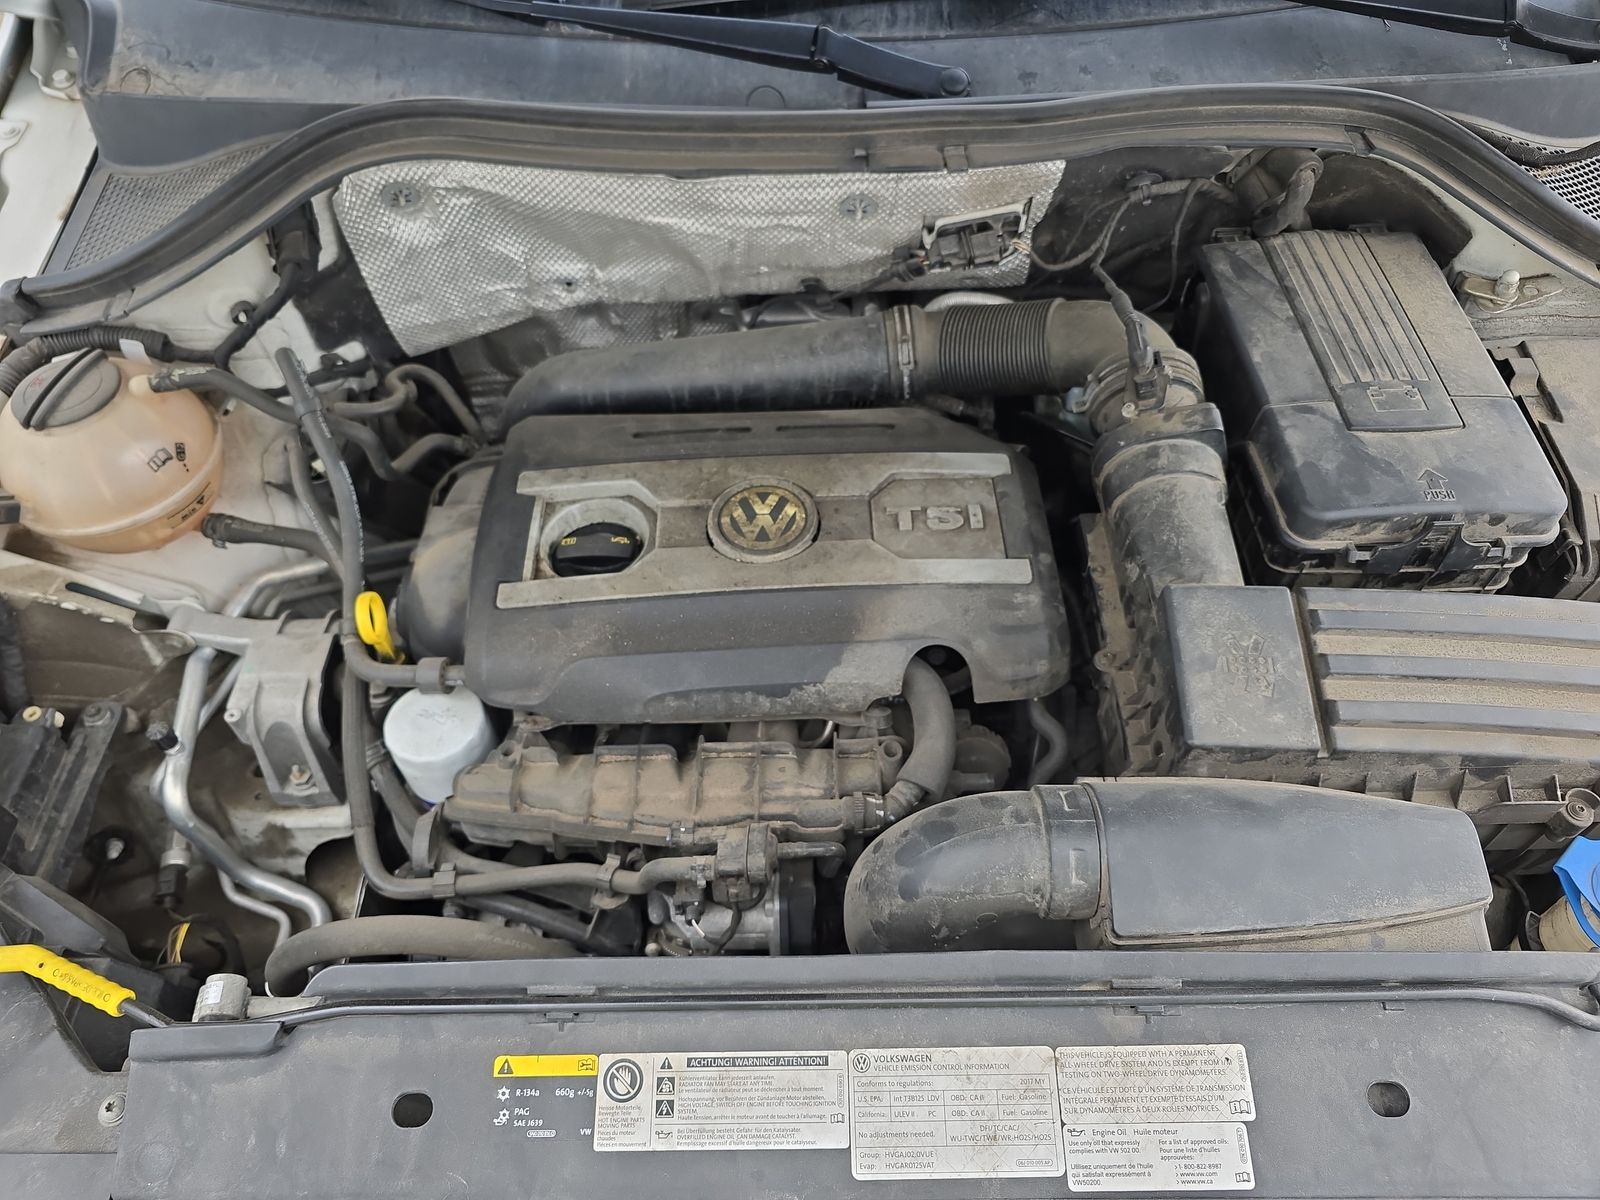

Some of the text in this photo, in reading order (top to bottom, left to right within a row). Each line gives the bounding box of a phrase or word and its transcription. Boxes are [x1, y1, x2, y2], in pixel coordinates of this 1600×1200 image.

[1424, 490, 1455, 500] PUSH
[886, 504, 984, 531] TSI
[873, 1054, 932, 1062] VOLKSWAGEN
[1113, 1051, 1146, 1059] EQUIPPED
[690, 1057, 826, 1067] ACHTUNG! WARNING! ATTENTION!
[896, 1080, 934, 1088] regulations:
[555, 1088, 574, 1098] 660g
[514, 1107, 530, 1116] PAG
[869, 1131, 908, 1139] adjustments
[1092, 1129, 1115, 1138] Engine
